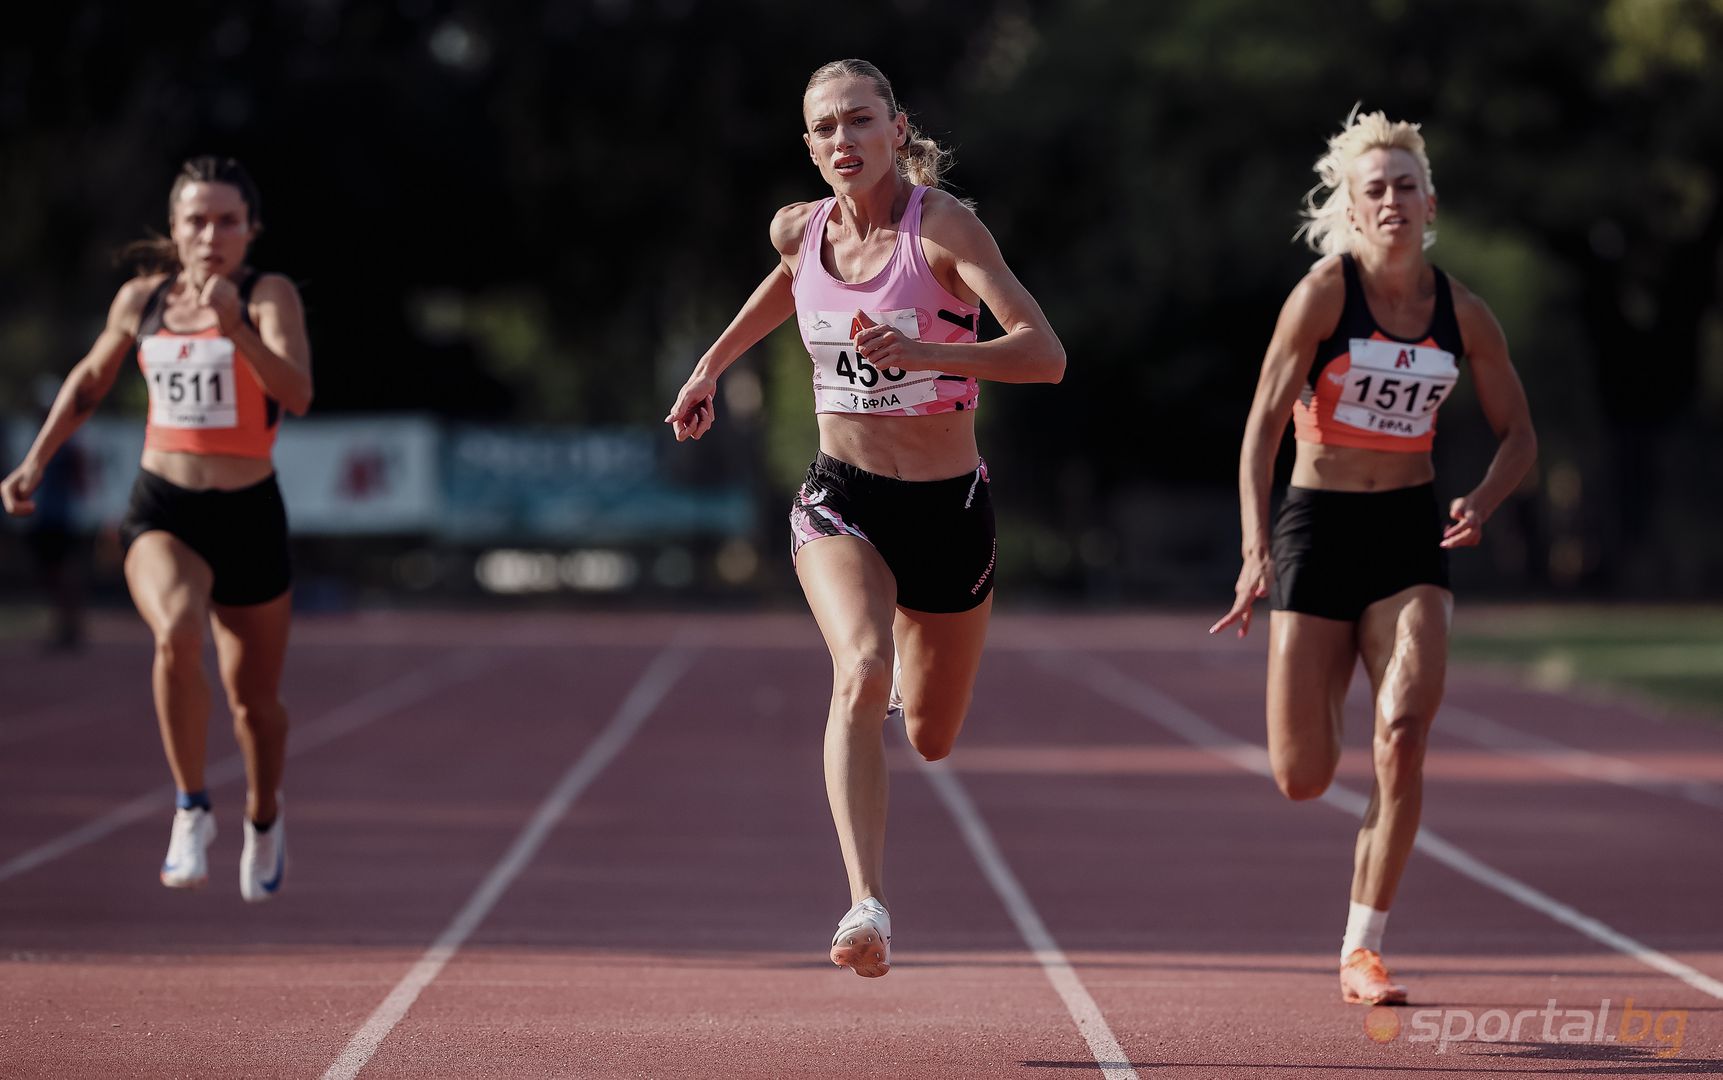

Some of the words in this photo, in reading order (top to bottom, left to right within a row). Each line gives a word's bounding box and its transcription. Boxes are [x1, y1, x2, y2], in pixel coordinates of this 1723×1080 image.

[1395, 348, 1416, 369] A1
[862, 394, 901, 409] БФЛА
[1355, 375, 1447, 413] 1515
